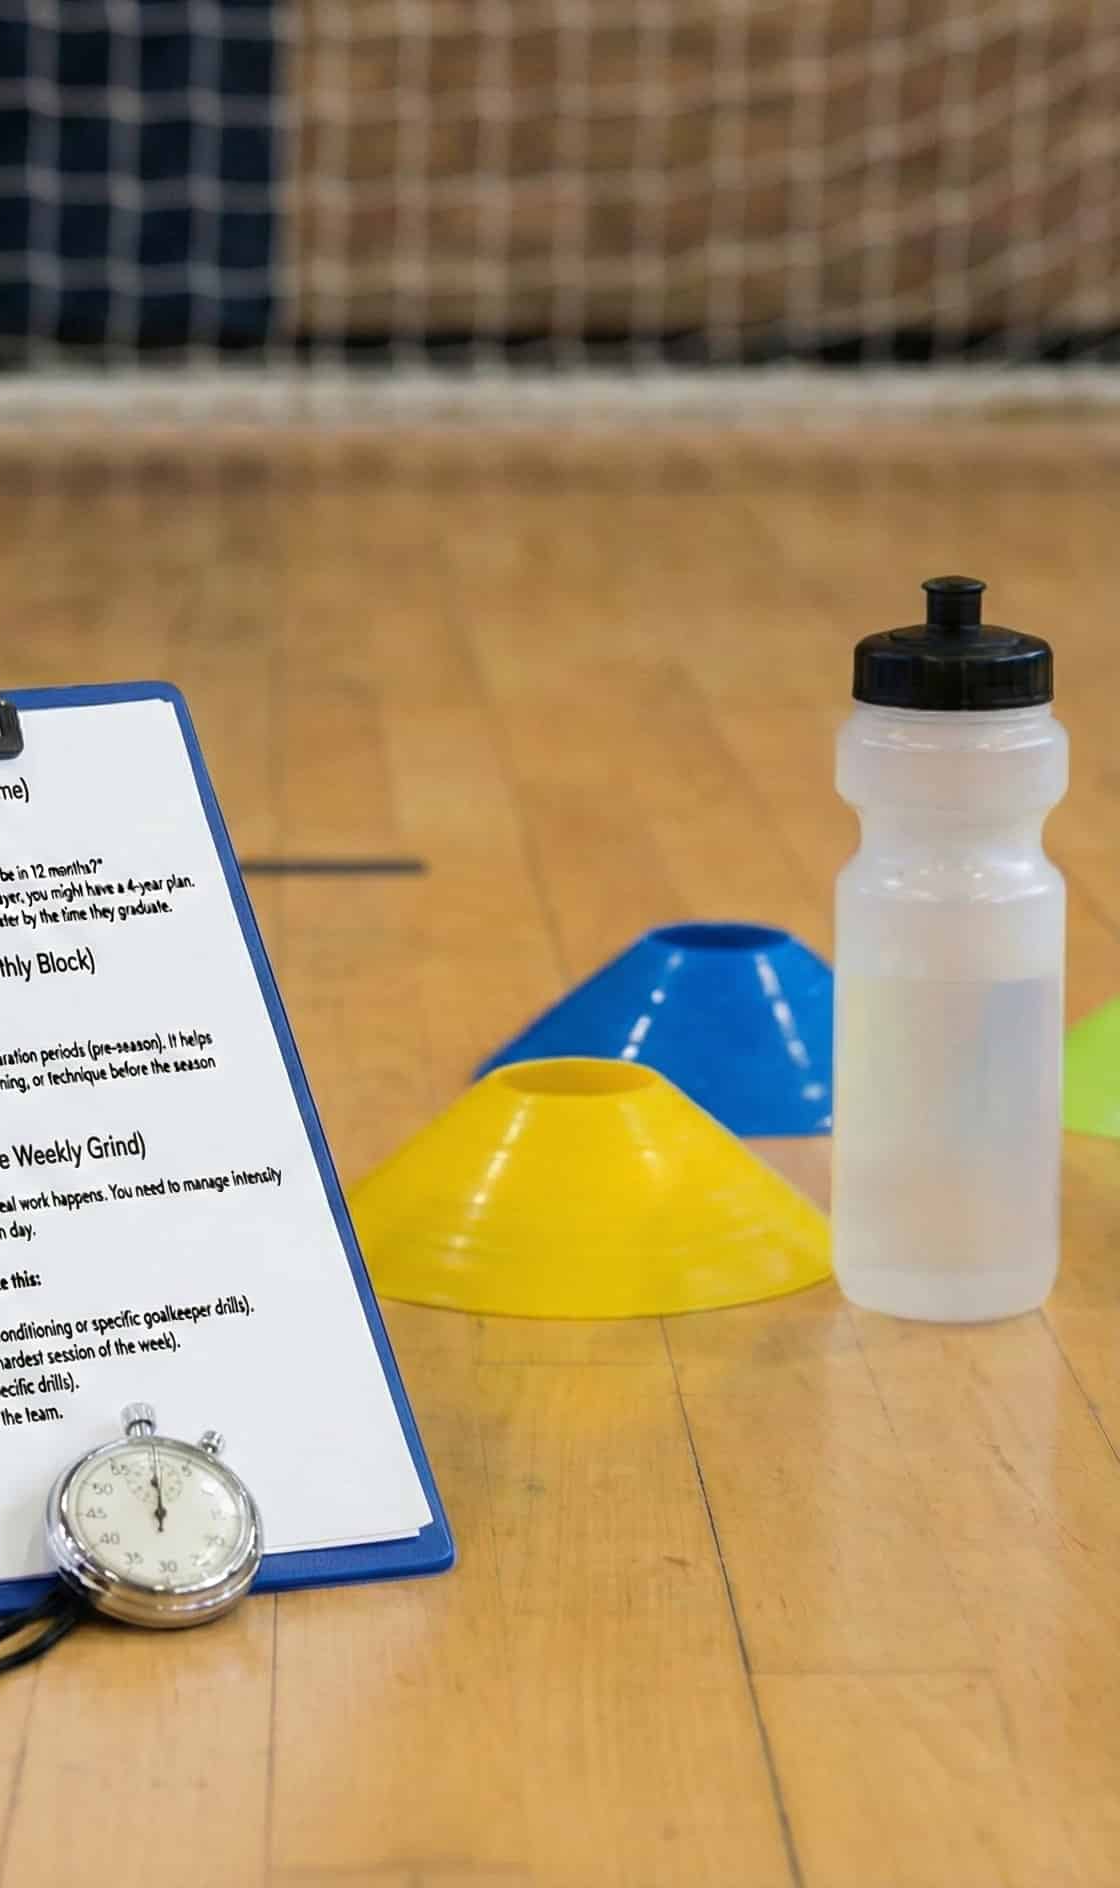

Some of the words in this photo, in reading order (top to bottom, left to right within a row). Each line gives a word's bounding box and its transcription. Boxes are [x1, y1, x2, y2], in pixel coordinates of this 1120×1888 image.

[15, 865, 29, 880] in
[30, 863, 46, 878] 12
[25, 890, 48, 907] you
[166, 873, 195, 894] plan.
[20, 909, 36, 929] by
[39, 907, 60, 923] the
[60, 906, 88, 922] time
[88, 903, 114, 922] they
[35, 946, 95, 975] Block)
[39, 1040, 86, 1067] periods
[178, 1029, 213, 1050] helps
[31, 1074, 44, 1087] or
[47, 1065, 107, 1086] technique
[108, 1060, 148, 1079] before
[150, 1057, 171, 1074] the
[11, 1138, 82, 1168] Weekly
[86, 1130, 146, 1160] Grind)
[18, 1191, 50, 1211] work
[50, 1190, 108, 1211] happens.
[107, 1183, 133, 1200] You
[135, 1178, 165, 1197] need
[167, 1179, 181, 1193] to
[182, 1176, 230, 1192] manage
[9, 1220, 36, 1241] day.
[10, 1269, 41, 1288] this:
[75, 1319, 88, 1333] or
[91, 1309, 141, 1336] specific
[143, 1304, 211, 1329] goalkeeper
[214, 1294, 254, 1316] drills).
[47, 1343, 96, 1364] session
[98, 1339, 111, 1357] of
[113, 1337, 136, 1355] the
[137, 1331, 181, 1352] week).
[37, 1371, 79, 1393] drills).
[0, 1407, 23, 1425] the
[24, 1407, 63, 1423] team.
[93, 1483, 113, 1496] 50
[86, 1507, 107, 1519] 45
[99, 1532, 120, 1545] 40
[159, 1560, 177, 1574] 30
